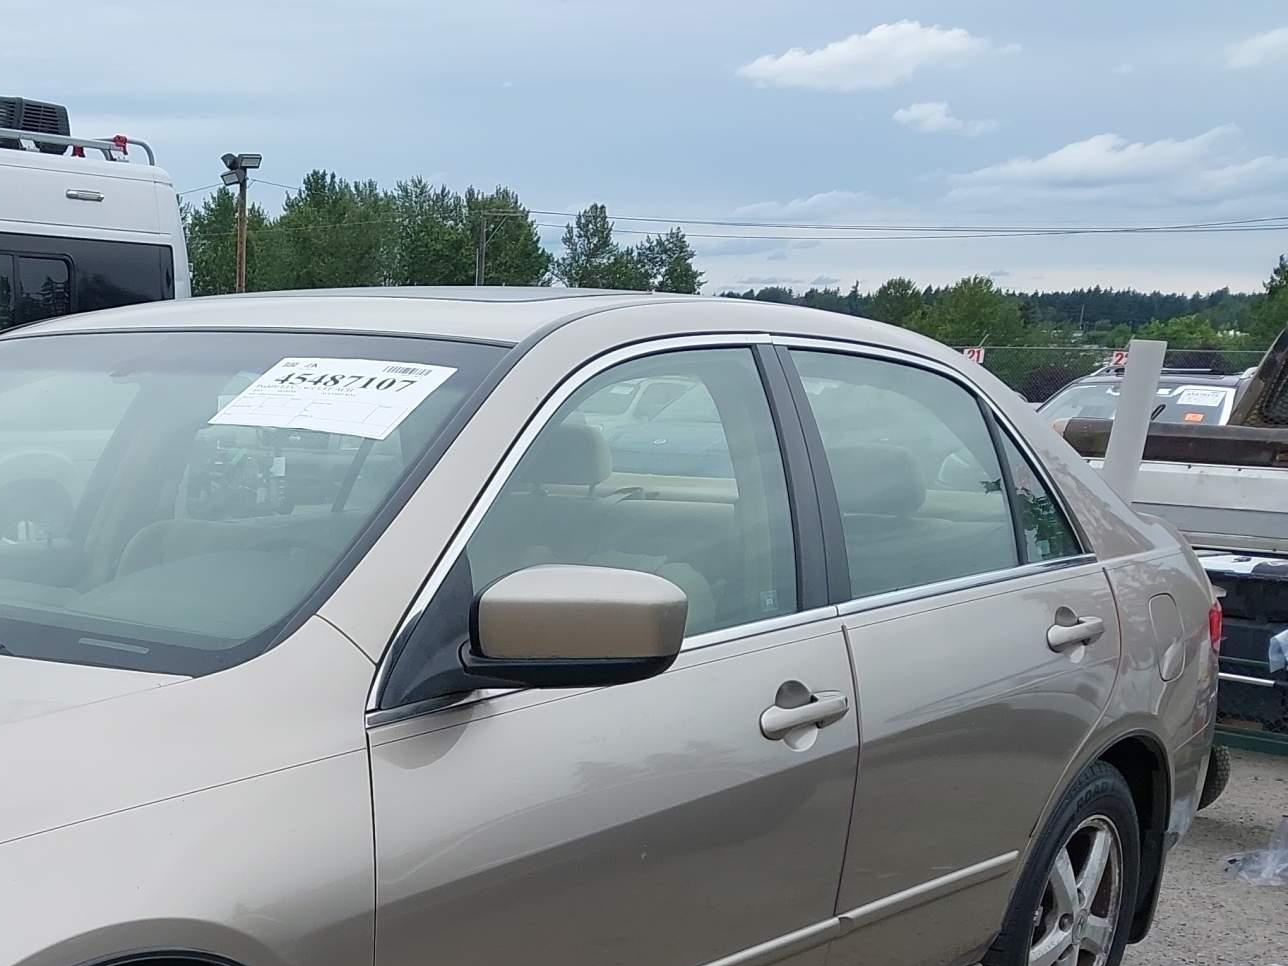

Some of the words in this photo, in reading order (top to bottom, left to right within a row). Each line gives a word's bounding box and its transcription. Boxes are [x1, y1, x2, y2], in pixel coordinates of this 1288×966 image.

[967, 349, 981, 363] 21
[1113, 352, 1129, 365] 2
[273, 371, 418, 392] 45487107
